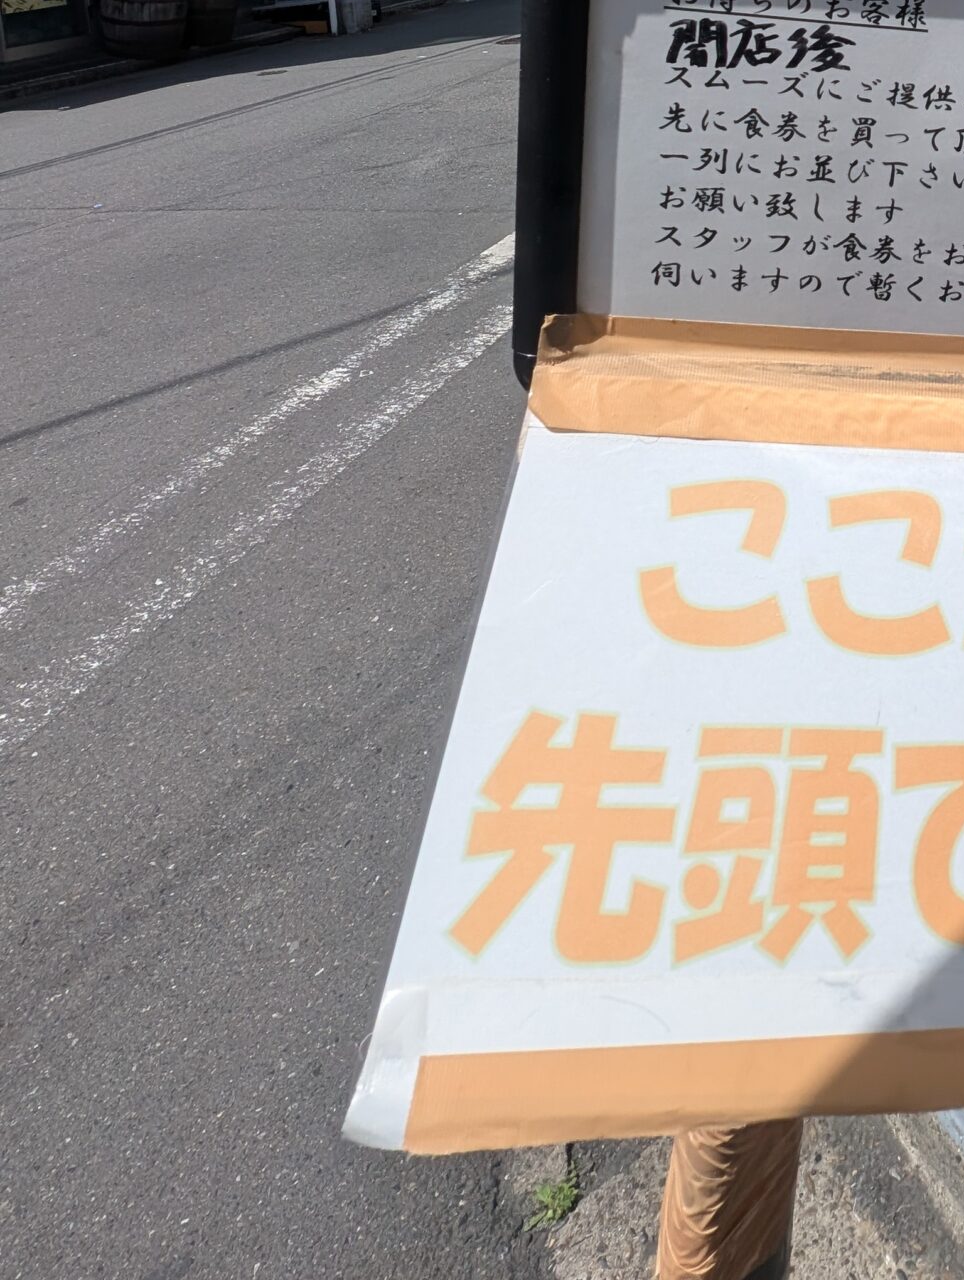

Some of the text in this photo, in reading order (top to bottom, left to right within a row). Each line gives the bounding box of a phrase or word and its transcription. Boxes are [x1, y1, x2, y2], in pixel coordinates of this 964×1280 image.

[666, 17, 857, 72] 開店後
[658, 184, 904, 225] お願い致します
